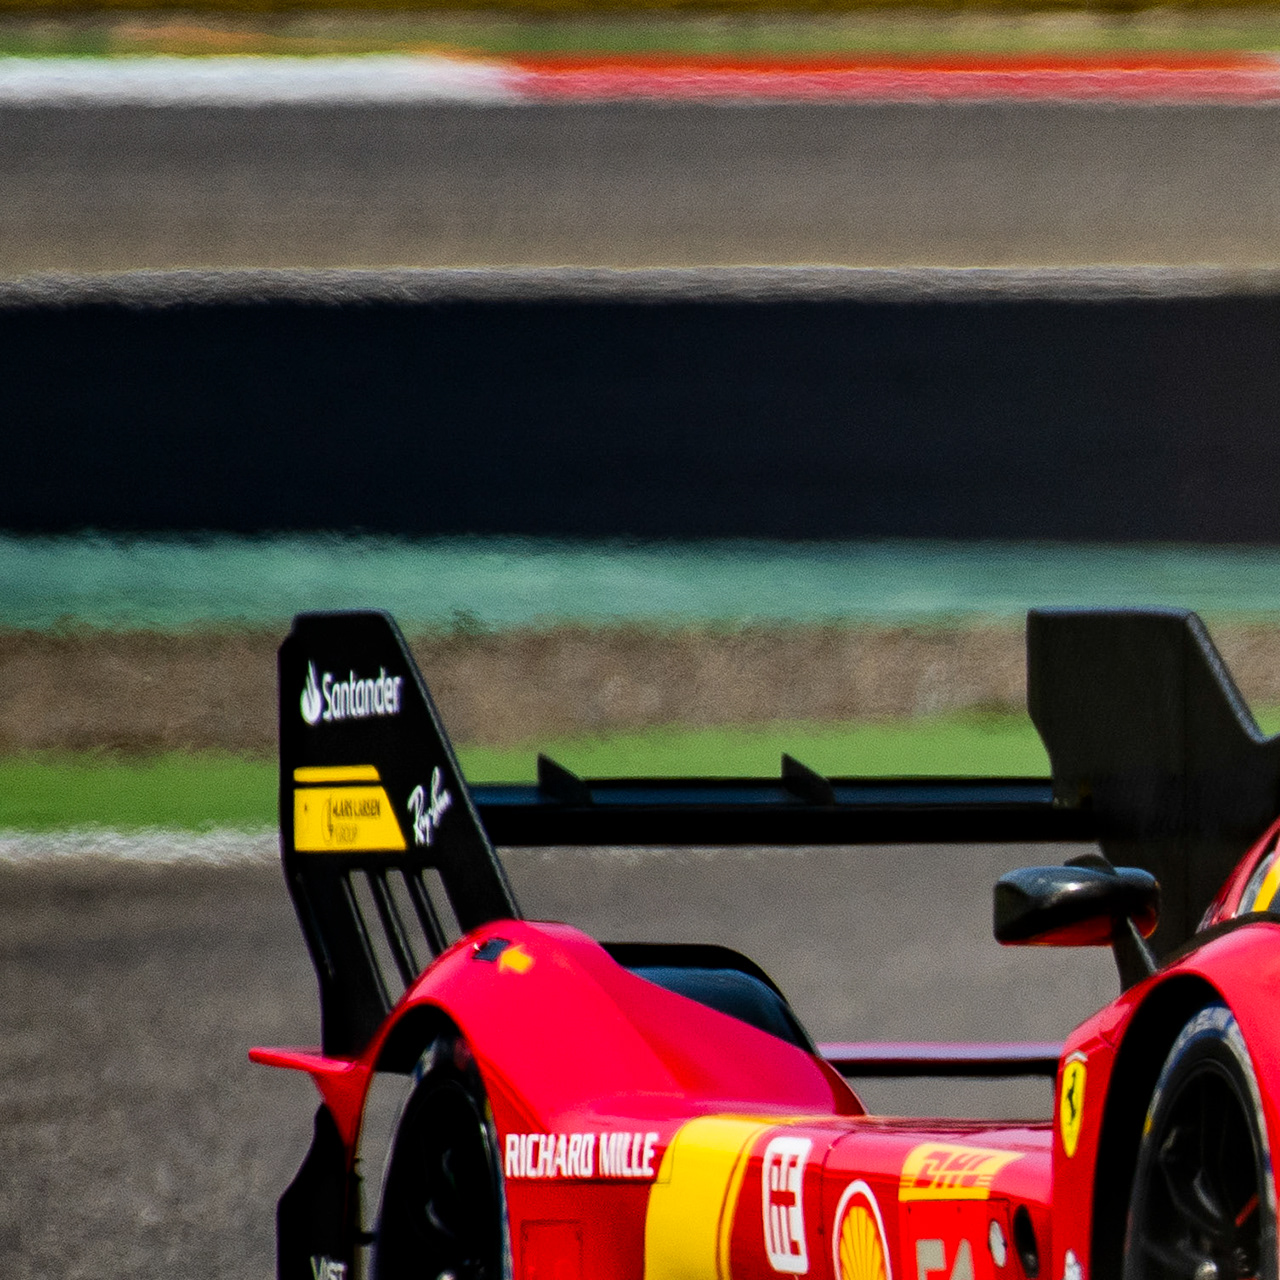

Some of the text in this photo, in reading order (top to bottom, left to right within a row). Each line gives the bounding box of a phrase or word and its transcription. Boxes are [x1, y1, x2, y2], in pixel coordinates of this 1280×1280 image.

[322, 666, 403, 721] Santander
[505, 1131, 659, 1178] RICHARD MILLE
